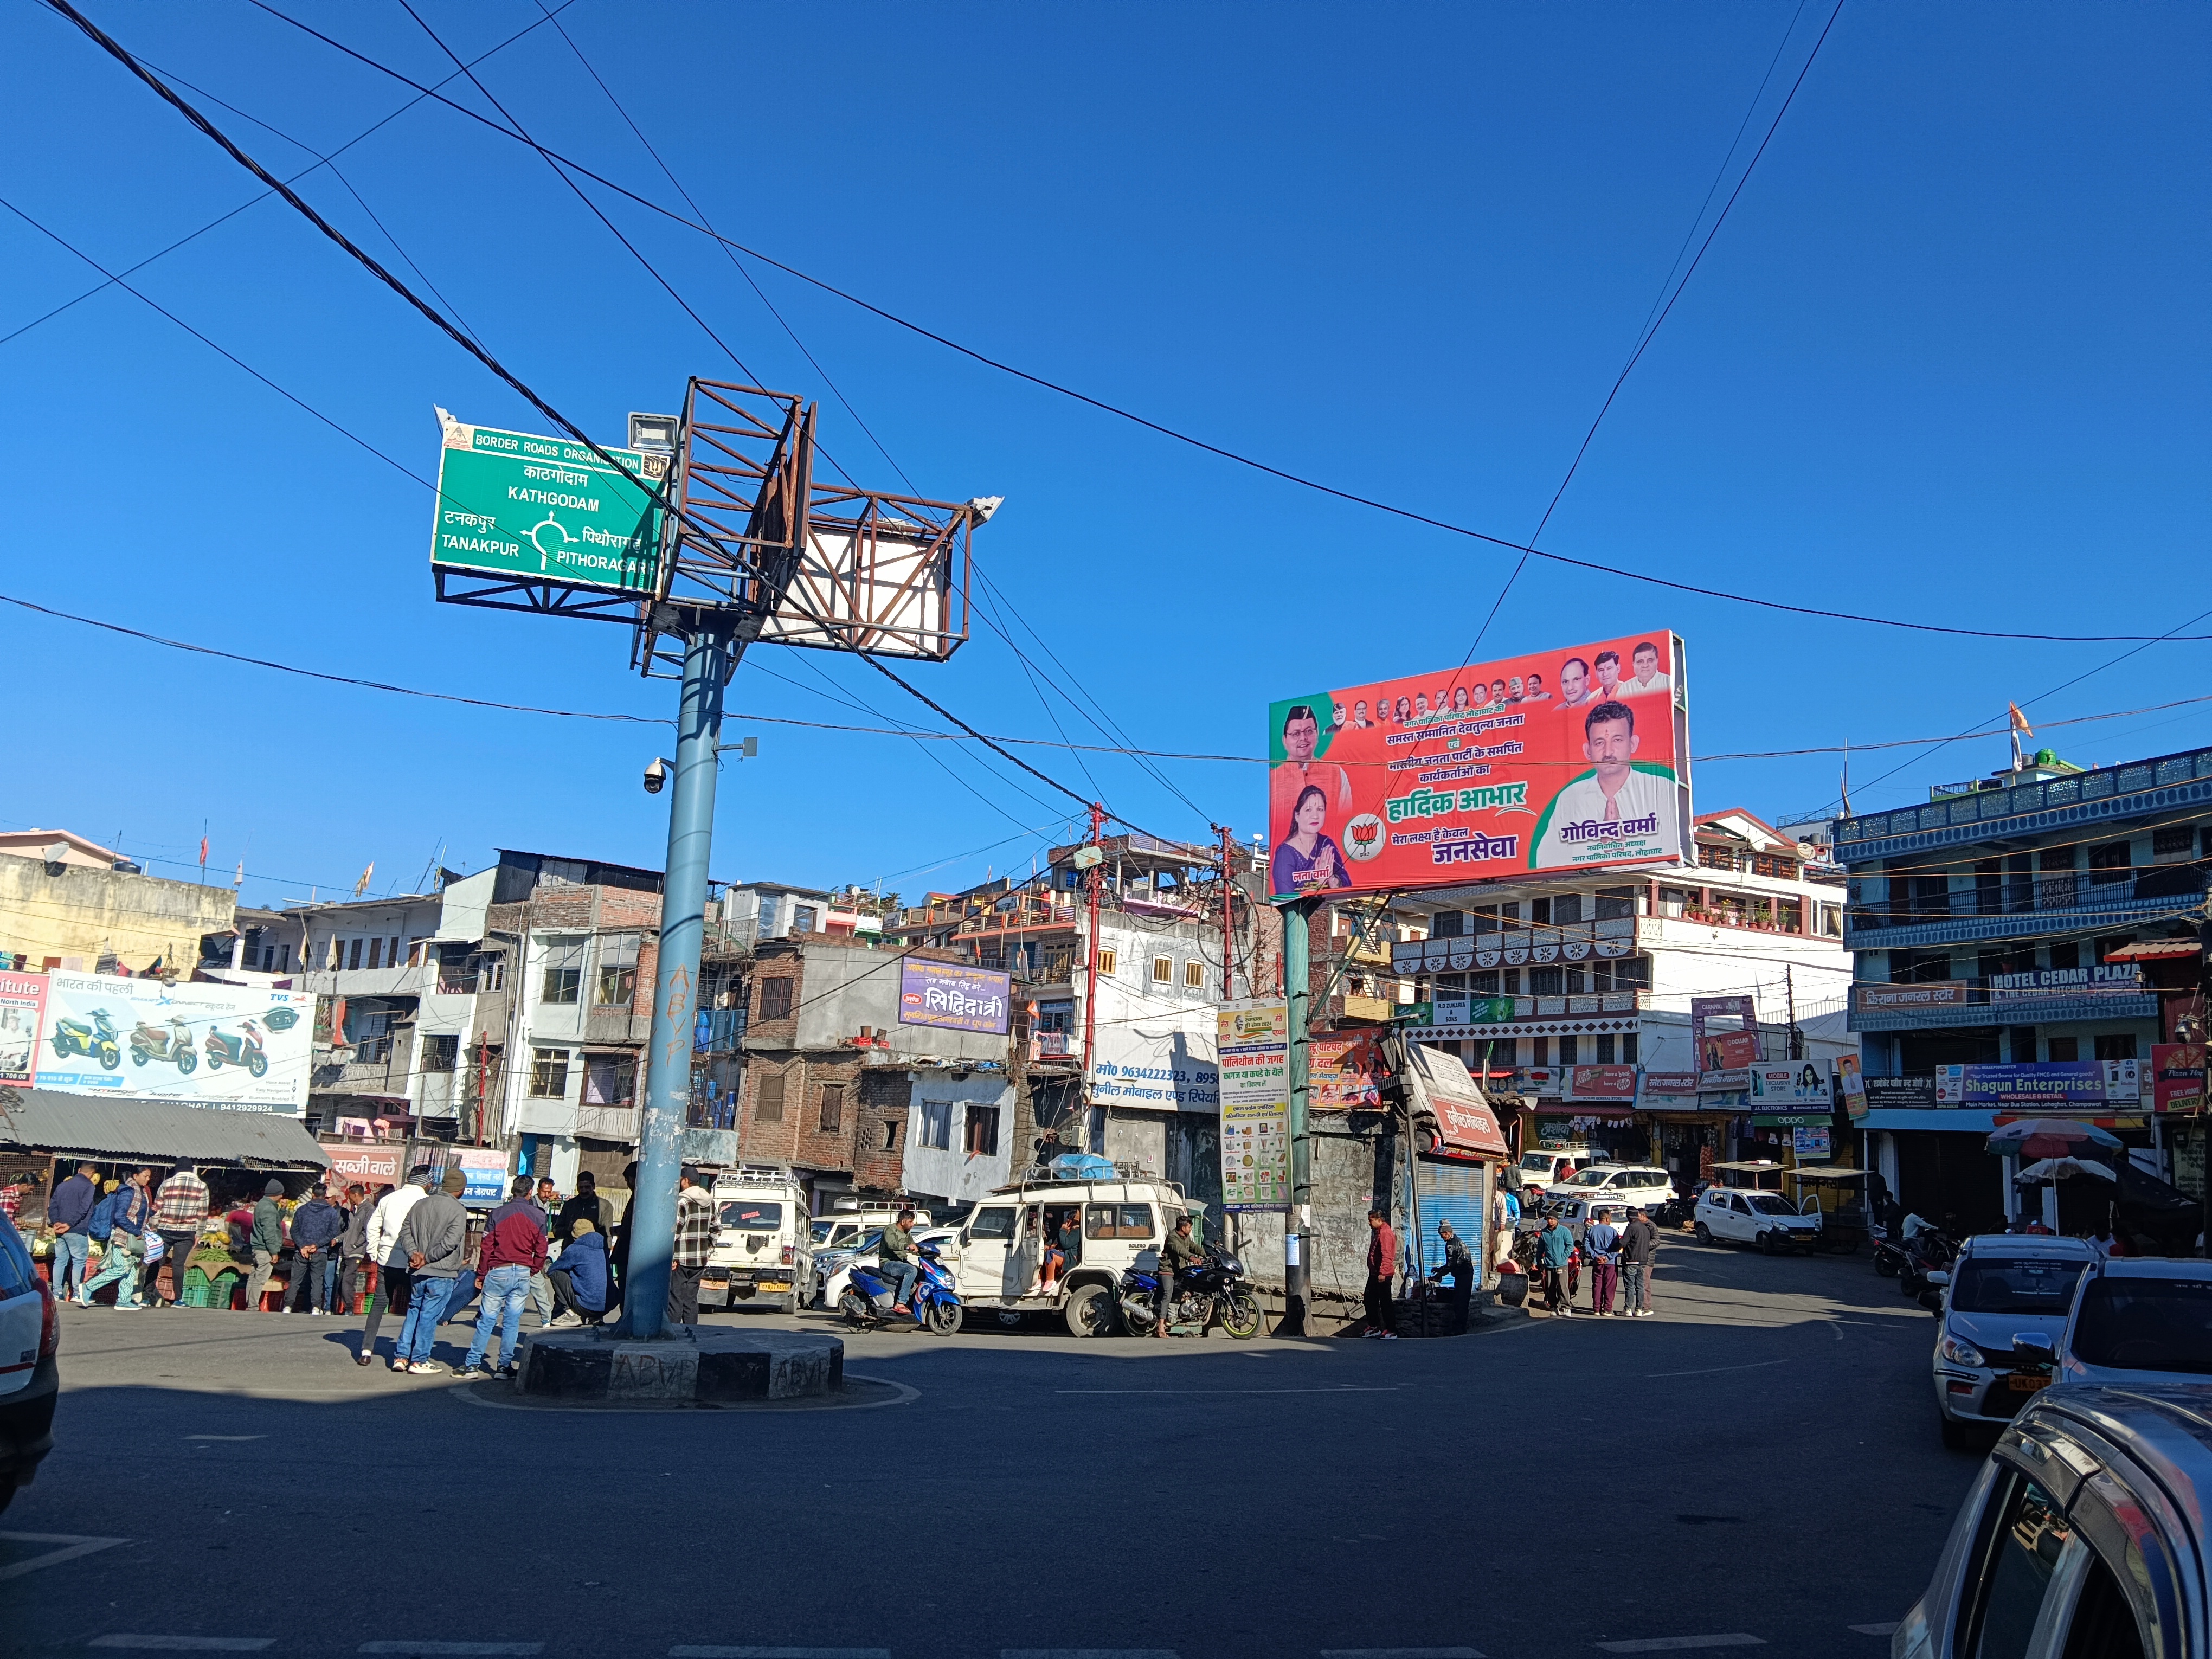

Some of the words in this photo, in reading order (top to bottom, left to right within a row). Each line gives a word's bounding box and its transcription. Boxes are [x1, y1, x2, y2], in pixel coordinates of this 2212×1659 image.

[475, 435, 518, 451] BORDER
[524, 442, 558, 456] ROADS
[524, 465, 589, 487] काठगोदाम
[508, 486, 599, 512] KATHGODAM
[445, 511, 496, 533] टनकपुर
[442, 535, 519, 557] TANAKPUR
[557, 550, 656, 576] PITHORAGARH
[1418, 716, 1443, 726] पालिका
[1444, 712, 1465, 722] परिषद
[1466, 706, 1494, 718] लोहाघाट
[1495, 704, 1504, 713] की
[1387, 733, 1414, 745] समस्त
[1416, 725, 1457, 741] सम्मानित
[1458, 722, 1494, 735] देवतुल्य
[1496, 715, 1524, 727] जनता
[1448, 739, 1461, 749] एवं
[1388, 756, 1422, 770] भारतीय
[1423, 753, 1450, 766] जनता
[1452, 747, 1472, 761] पार्टी
[1475, 747, 1484, 758] के
[1487, 741, 1522, 756] समर्पित
[1419, 766, 1475, 783] कार्यकर्ताओं
[1475, 764, 1490, 775] का
[1387, 788, 1455, 821] हार्दिक
[1459, 783, 1526, 809] आभार
[1392, 832, 1408, 845] मेरा
[1410, 833, 1431, 843] लक्ष्य
[1433, 828, 1441, 841] है
[1442, 827, 1469, 839] केवल
[1561, 820, 1619, 841] गोविन्द
[1622, 812, 1657, 834] वर्मा
[1432, 832, 1517, 863] जनसेवा
[1586, 852, 1610, 860] पालिका
[1635, 847, 1662, 856] लोहाघाट
[1587, 841, 1623, 851] नवनिर्वाचित
[1293, 871, 1311, 882] लता
[1312, 865, 1330, 879] वर्मा
[1994, 971, 2039, 989] HOTEL
[2040, 968, 2088, 986] CEDAR
[2094, 964, 2141, 981] PLAZA
[57, 978, 83, 991] भारत
[87, 978, 102, 992] की
[104, 982, 134, 995] पहली
[1866, 991, 1898, 1005] किराना
[1898, 991, 1931, 1003] जनरल
[1933, 986, 1955, 1001] स्टोर
[1995, 991, 2002, 999] &
[2005, 988, 2020, 999] THE
[2022, 986, 2050, 997] CEDAR
[2052, 985, 2087, 994] KITCHEN
[270, 993, 289, 1002] TVS
[1221, 1055, 1254, 1068] पॉलिथीन
[1255, 1053, 1265, 1065] की
[1266, 1054, 1284, 1064] जगह
[1317, 1057, 1334, 1069] दल
[1223, 1071, 1240, 1079] कागज
[1264, 1068, 1271, 1077] के
[1272, 1067, 1284, 1076] थैले
[1662, 1078, 1681, 1087] जनरल
[1681, 1077, 1694, 1087] स्टोर
[1702, 1075, 1722, 1084] मनीष
[1092, 1081, 1122, 1098] सुनील
[1123, 1084, 1164, 1100] मोबाइल
[1165, 1090, 1186, 1102] एण्ड
[1965, 1079, 2012, 1095] Shagun
[2016, 1077, 2102, 1094] Enterprises
[2170, 1090, 2184, 1098] FREE
[2184, 1087, 2200, 1095] HOME
[220, 1103, 273, 1112] 9412929924
[335, 1154, 370, 1174] सब्जी
[370, 1156, 397, 1176] वाले
